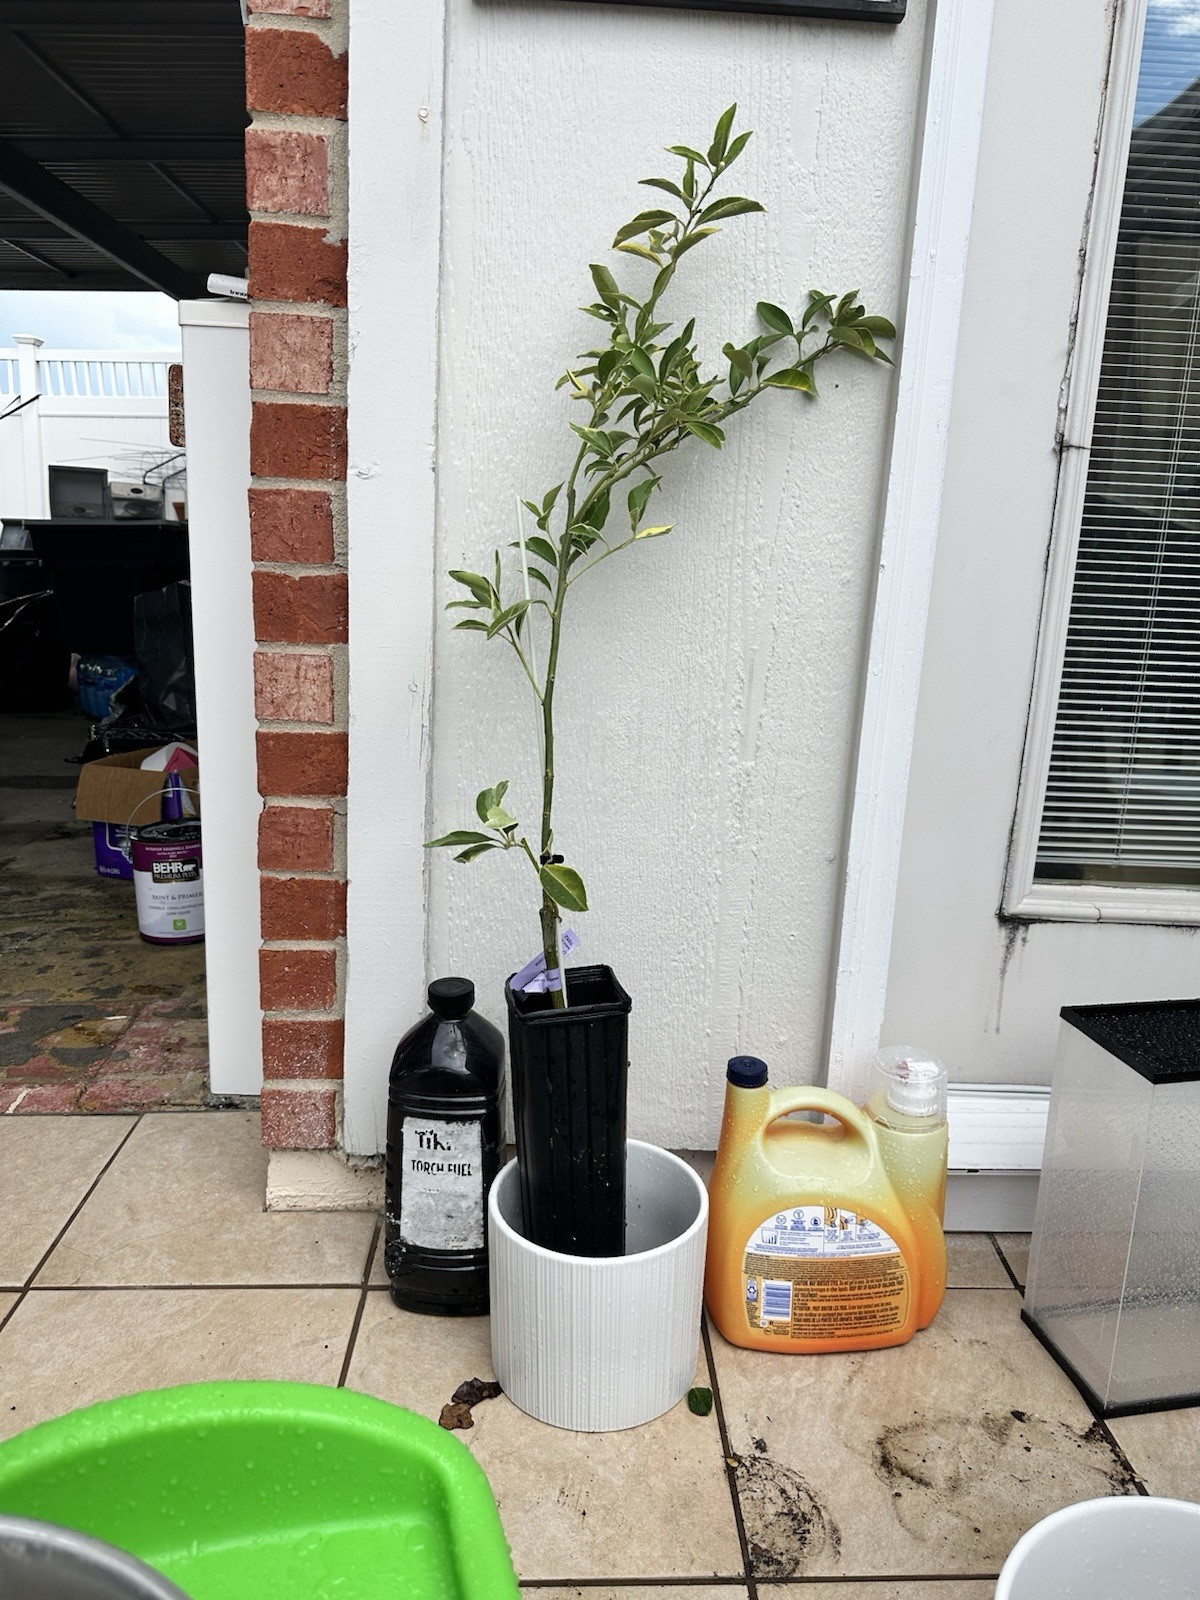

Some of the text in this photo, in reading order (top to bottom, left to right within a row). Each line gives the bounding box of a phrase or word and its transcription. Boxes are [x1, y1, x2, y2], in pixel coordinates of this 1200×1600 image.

[152, 862, 183, 874] BEHR
[412, 1160, 472, 1176] TORCH FUEL
